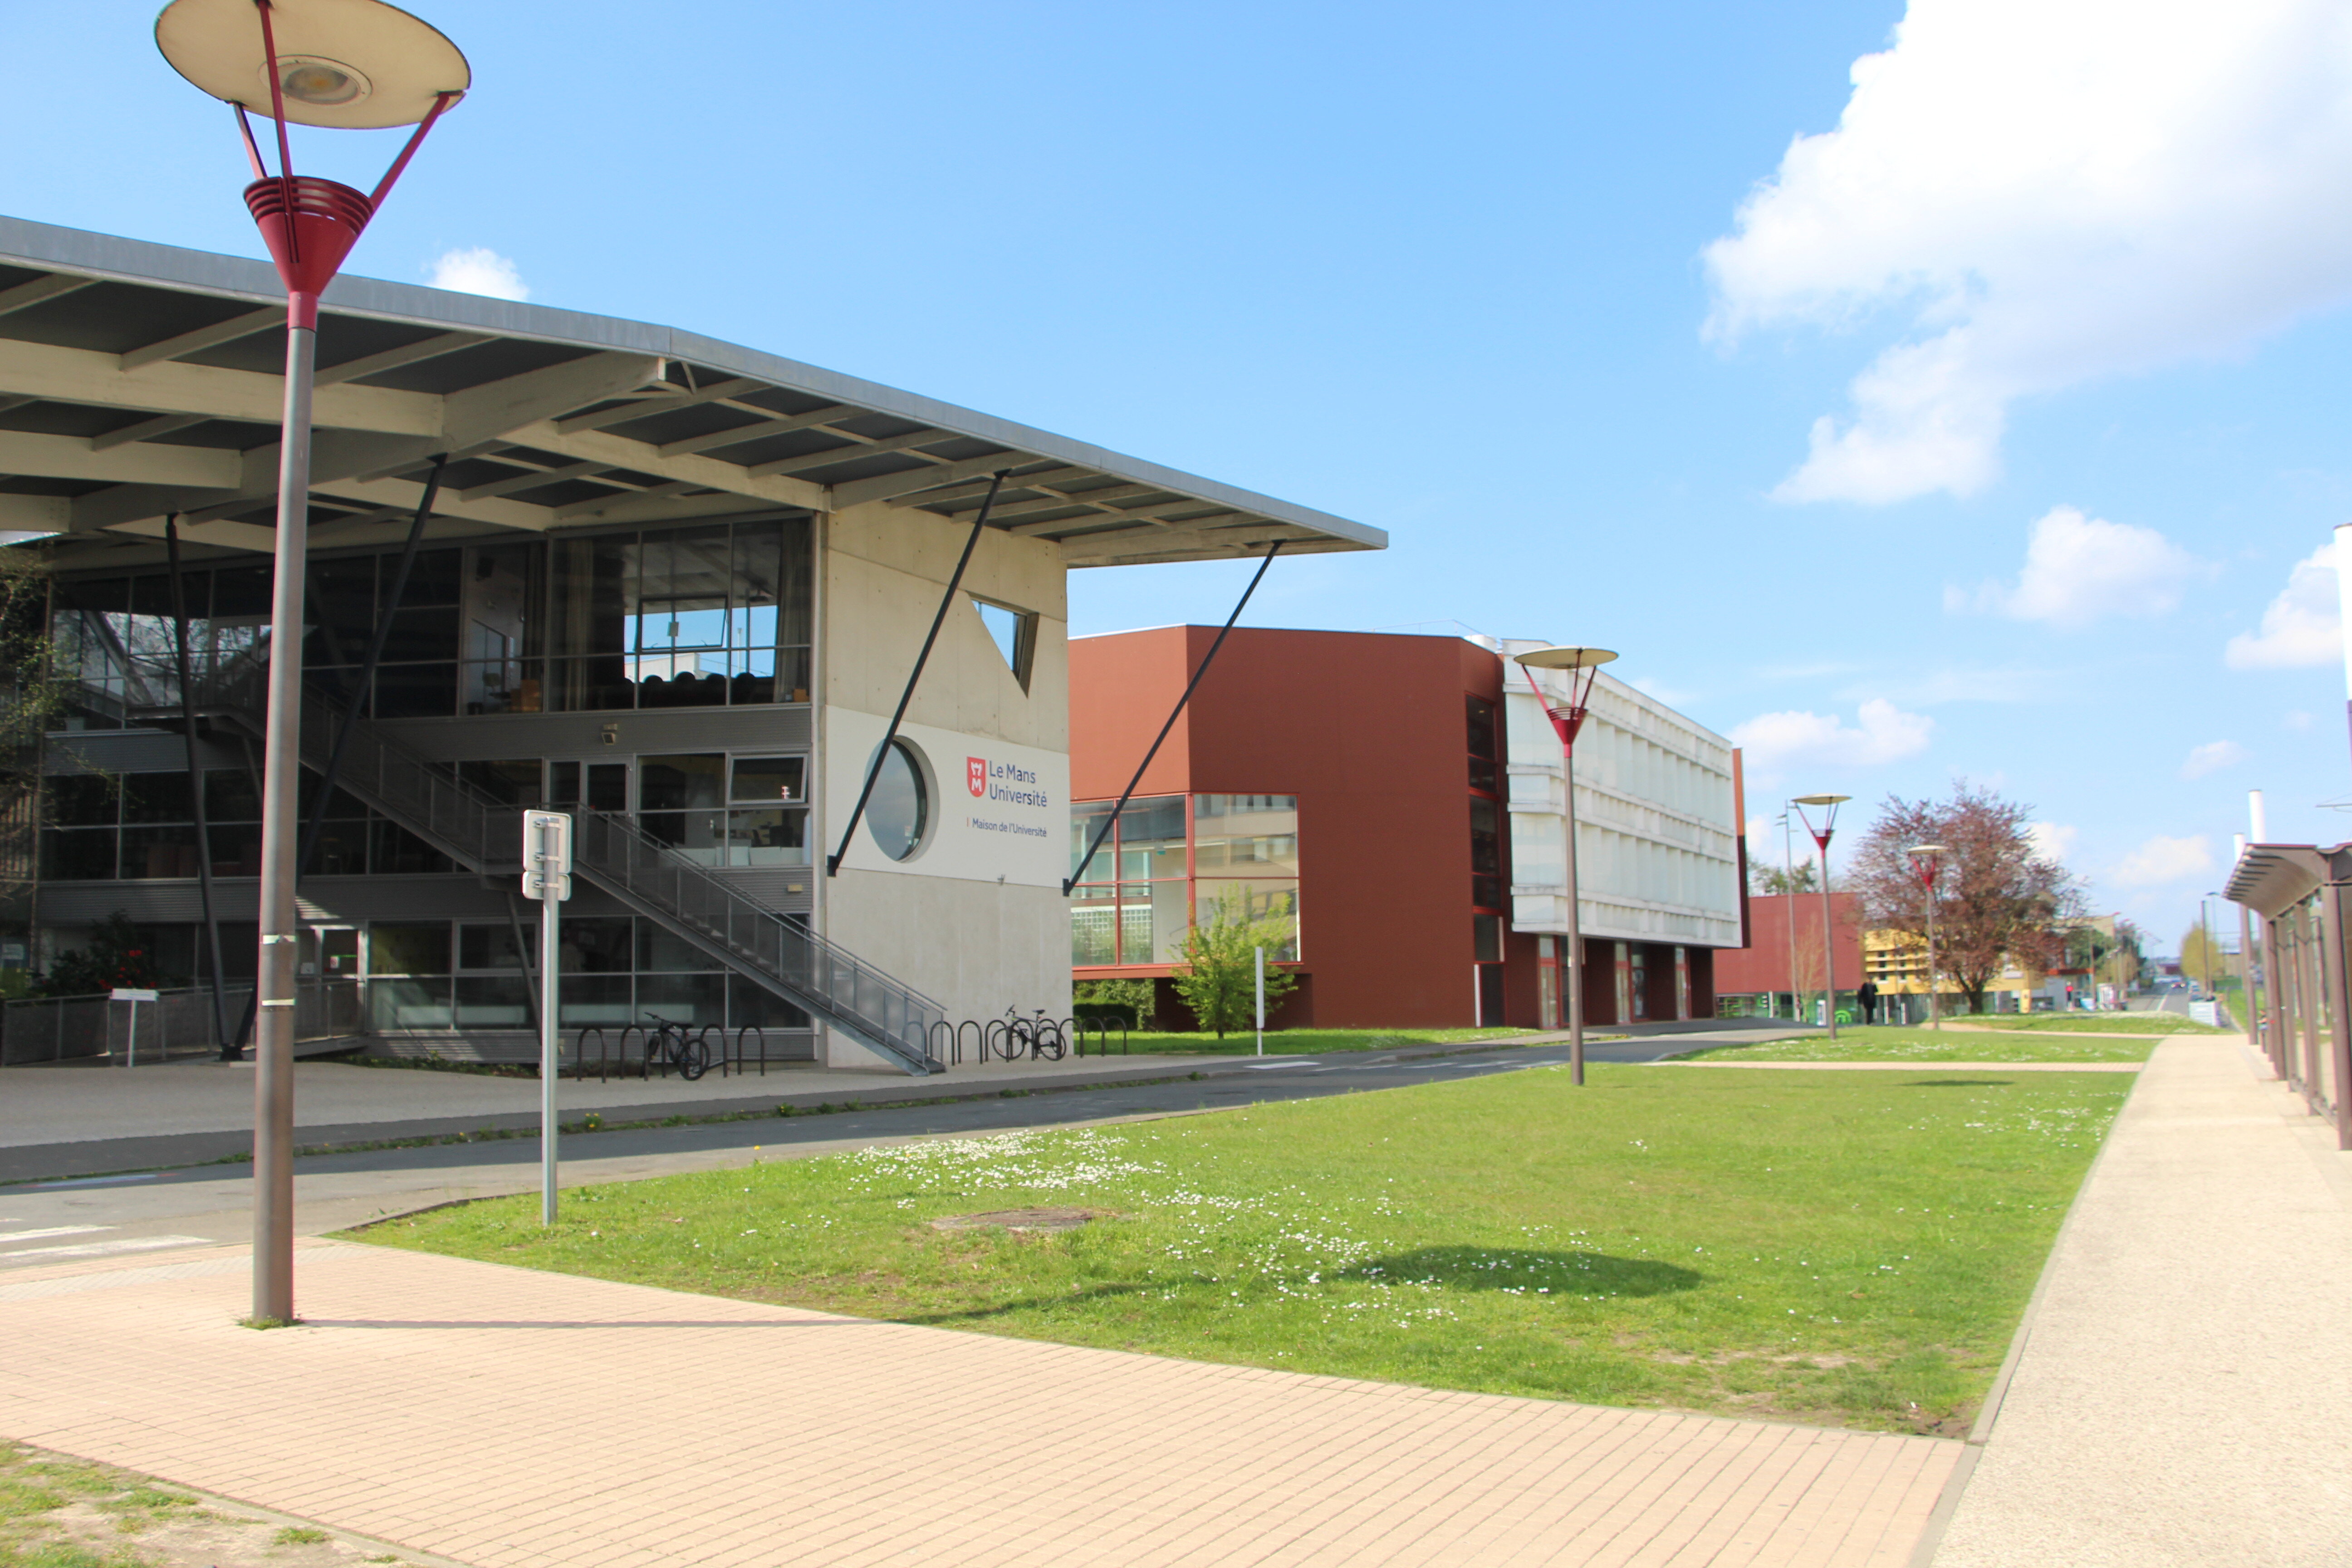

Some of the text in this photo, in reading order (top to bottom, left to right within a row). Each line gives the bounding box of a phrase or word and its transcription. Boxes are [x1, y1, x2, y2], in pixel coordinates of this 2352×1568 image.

[989, 760, 1035, 784] Le Mans
[989, 783, 1047, 807] Université
[972, 818, 1047, 837] Maison de l'Université
